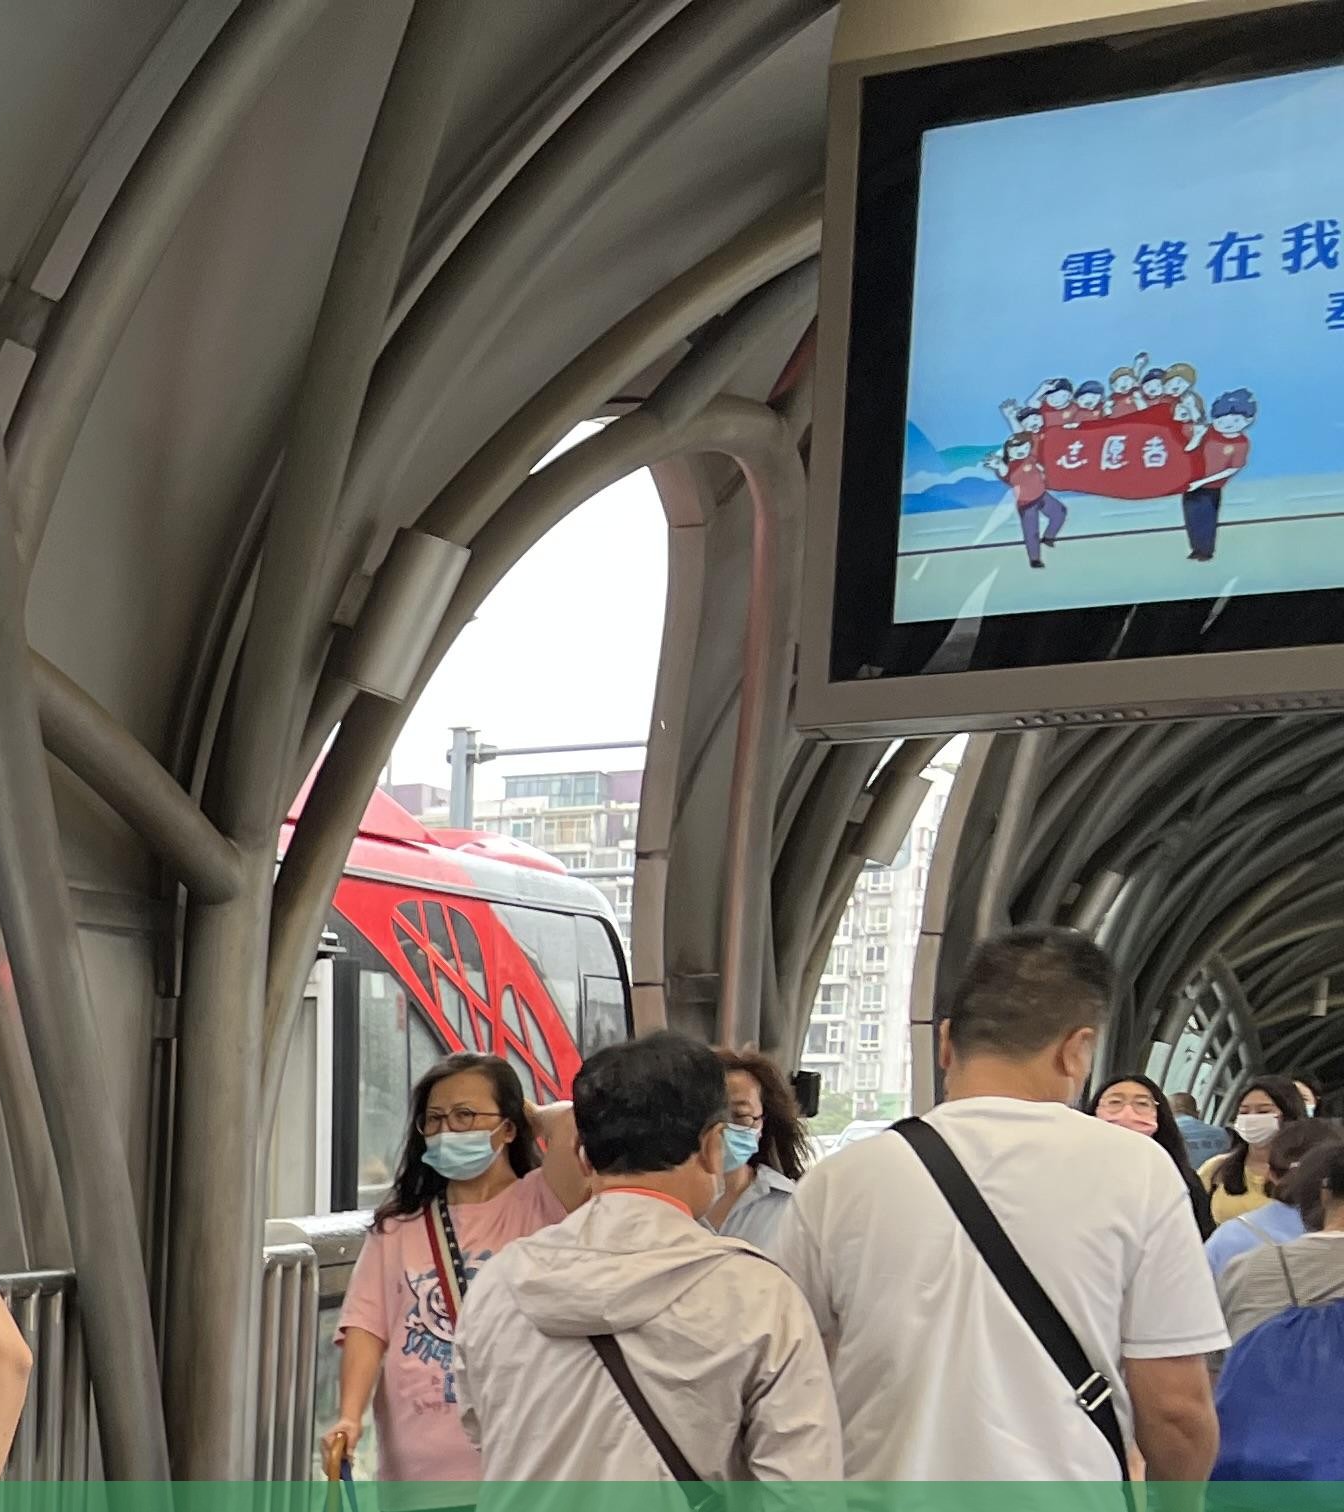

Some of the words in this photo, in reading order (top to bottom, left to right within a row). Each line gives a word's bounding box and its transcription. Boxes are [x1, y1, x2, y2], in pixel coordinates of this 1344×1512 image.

[1061, 219, 1341, 302] 雷锋在我
[1056, 435, 1169, 470] 志愿者
